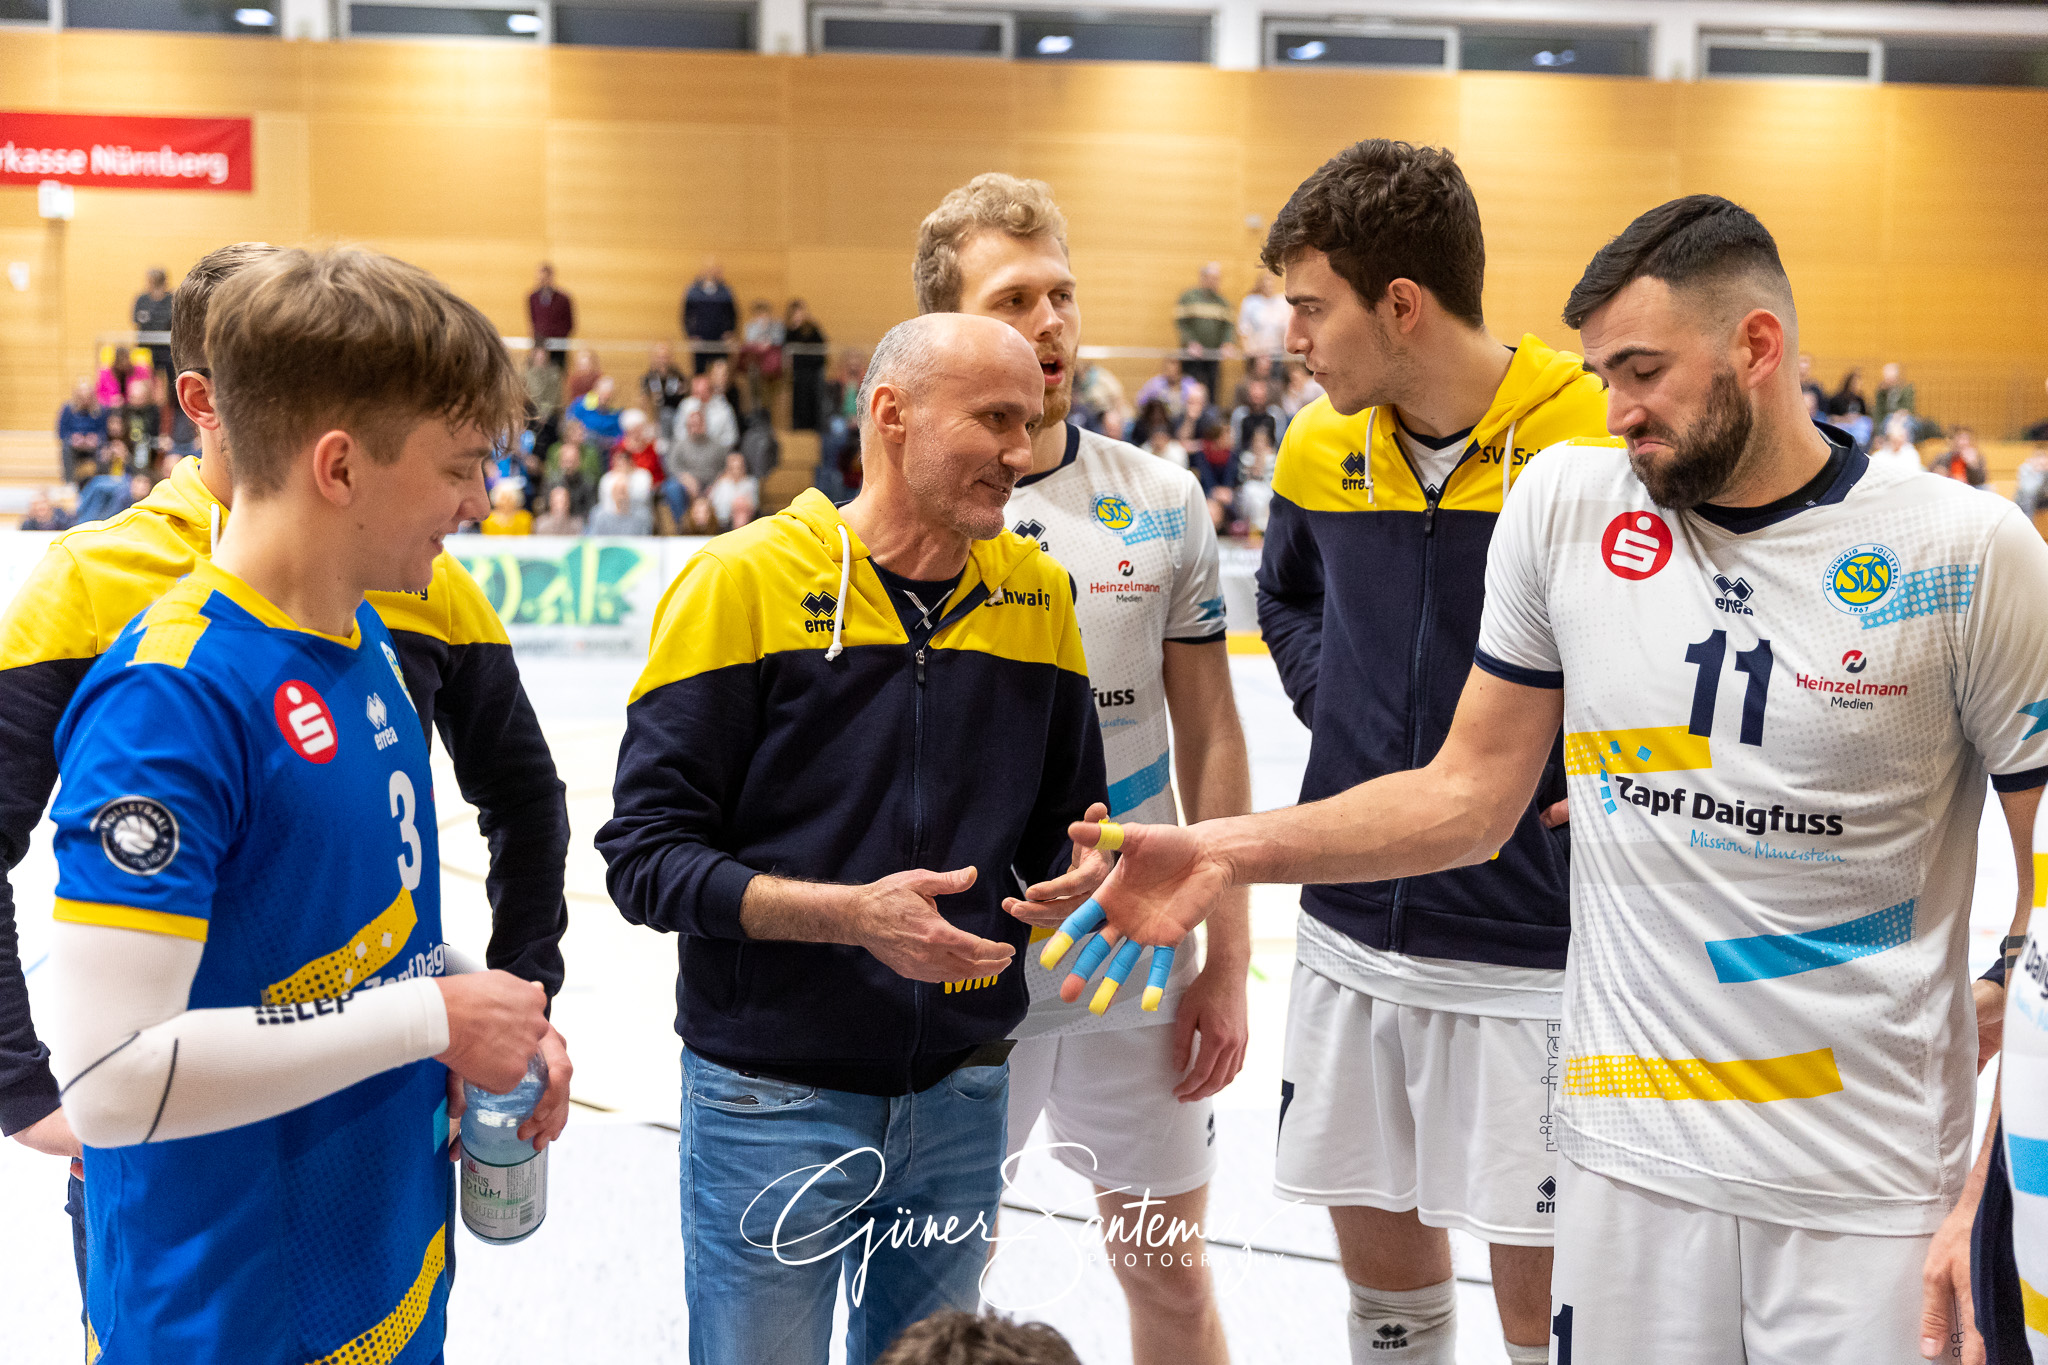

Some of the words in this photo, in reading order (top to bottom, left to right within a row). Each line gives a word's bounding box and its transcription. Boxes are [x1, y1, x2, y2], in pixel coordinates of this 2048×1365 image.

[91, 144, 229, 184] Nürnberg
[1480, 446, 1505, 465] SV
[1342, 478, 1373, 491] erre
[1826, 548, 1859, 579] SCHWAIG
[1872, 546, 1899, 591] VOLLEYBALL
[984, 587, 1051, 611] hwaig
[1090, 580, 1160, 594] Heinzelmann
[1684, 628, 1774, 747] 11
[1796, 672, 1908, 696] Heinzelmann
[1830, 696, 1874, 710] Medien
[1615, 775, 1687, 816] Zapf
[1691, 792, 1844, 836] Daigfuss
[389, 770, 422, 891] 3
